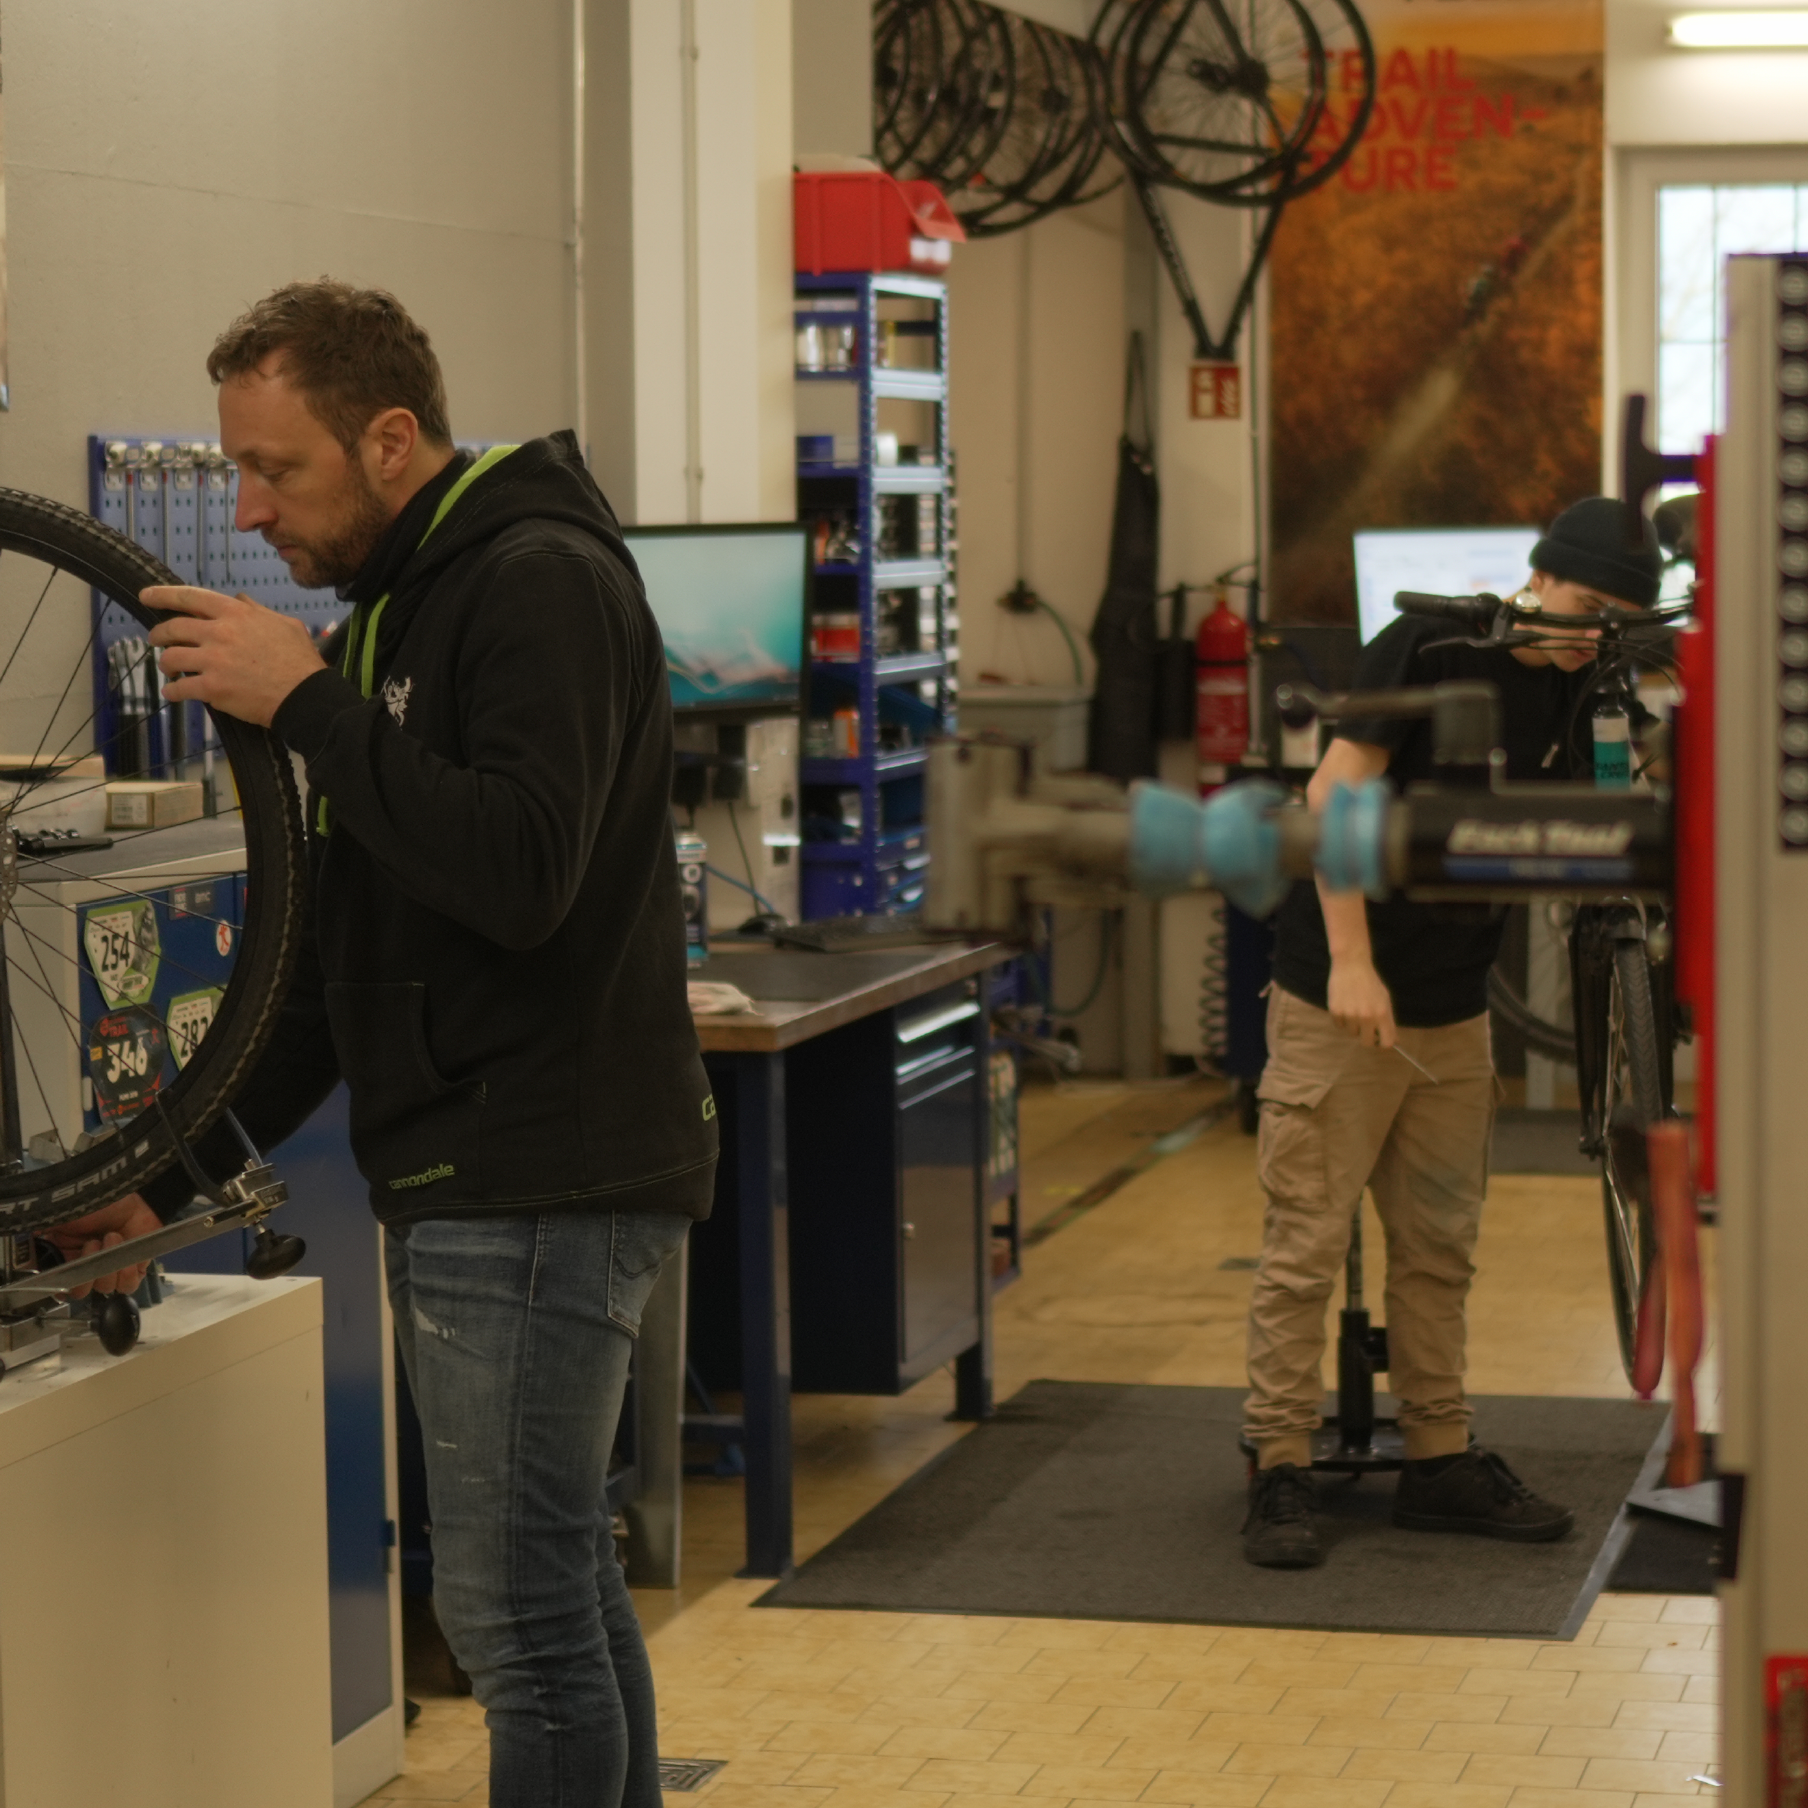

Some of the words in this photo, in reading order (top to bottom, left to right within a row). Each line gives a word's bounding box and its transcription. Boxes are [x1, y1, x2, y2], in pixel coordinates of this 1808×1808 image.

[101, 931, 130, 973] 254
[106, 1037, 148, 1084] 346
[388, 1163, 456, 1190] cannondale
